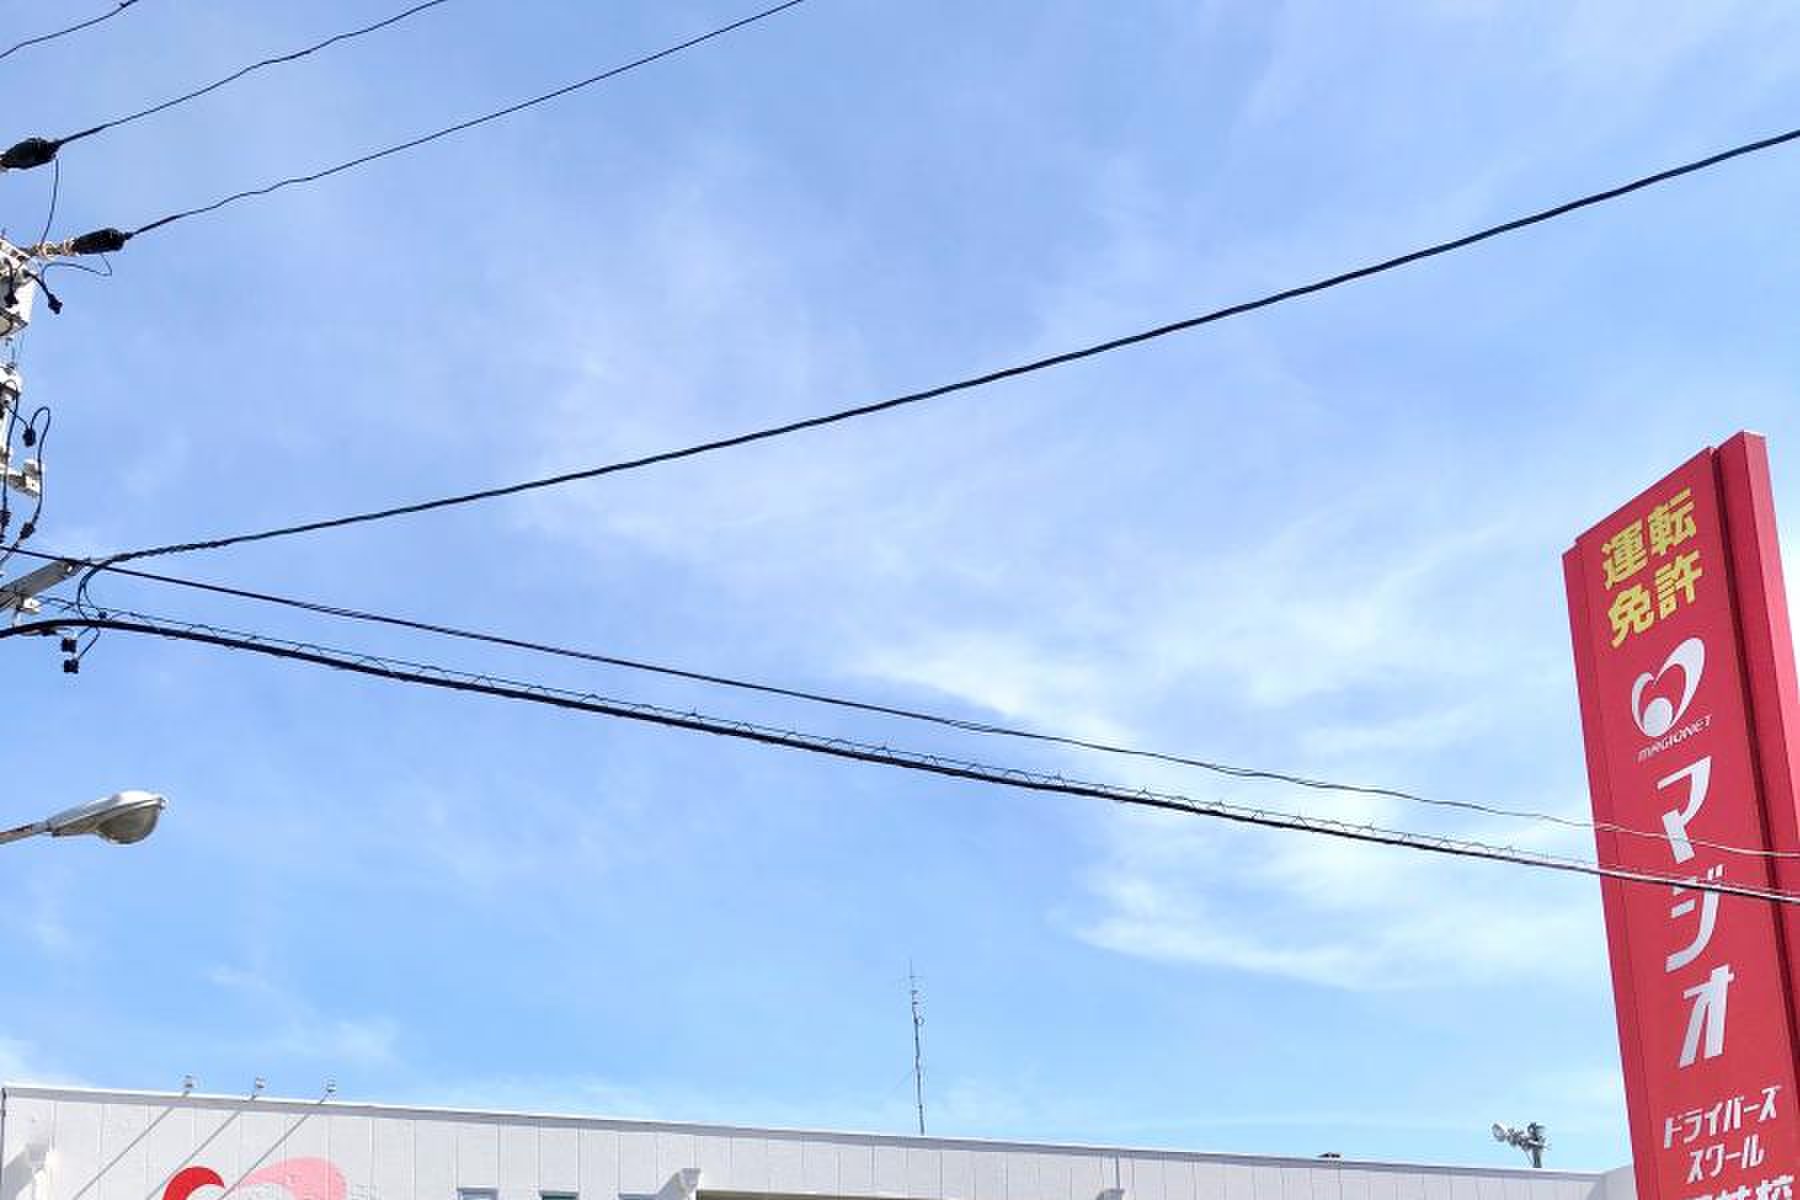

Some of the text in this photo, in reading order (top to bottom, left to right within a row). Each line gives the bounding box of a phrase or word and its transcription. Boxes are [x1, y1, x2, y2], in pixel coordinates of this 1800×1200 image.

[1601, 487, 1697, 589] 運転
[1607, 550, 1703, 648] 免許
[1637, 714, 1712, 762] MAGIONET
[1656, 756, 1735, 1069] マジオ
[1664, 1086, 1782, 1149] ドライバーズ
[1686, 1134, 1764, 1184] スクール
